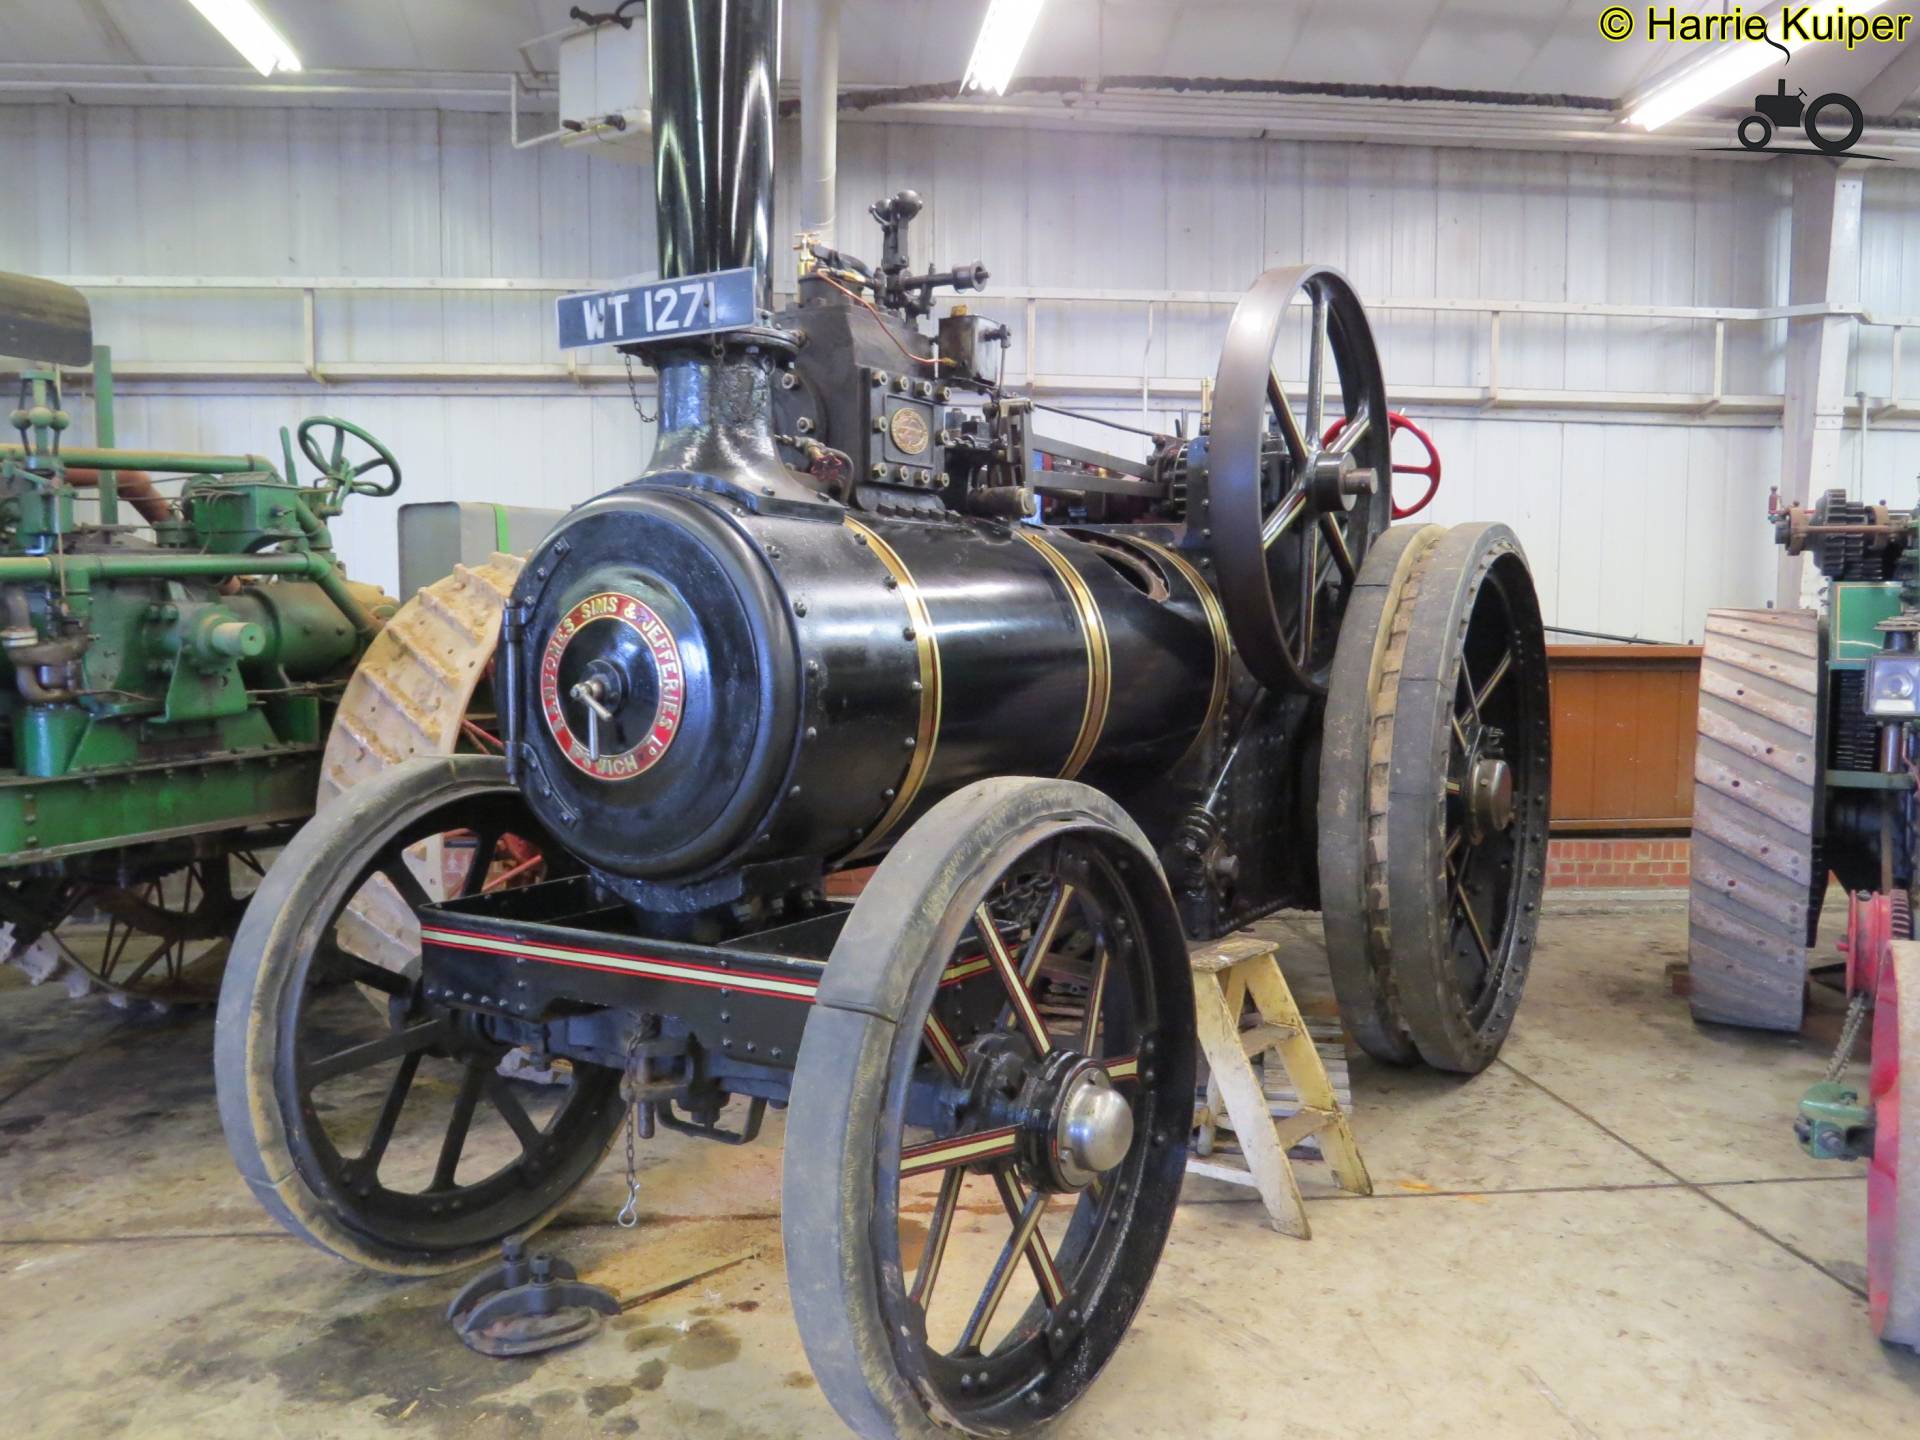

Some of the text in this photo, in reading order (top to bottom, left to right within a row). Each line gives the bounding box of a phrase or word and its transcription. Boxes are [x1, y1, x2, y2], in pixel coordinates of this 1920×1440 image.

[583, 281, 717, 340] WT 1271
[581, 596, 618, 619] SIMS
[624, 602, 637, 620] &
[641, 619, 679, 730] JEFFERIES
